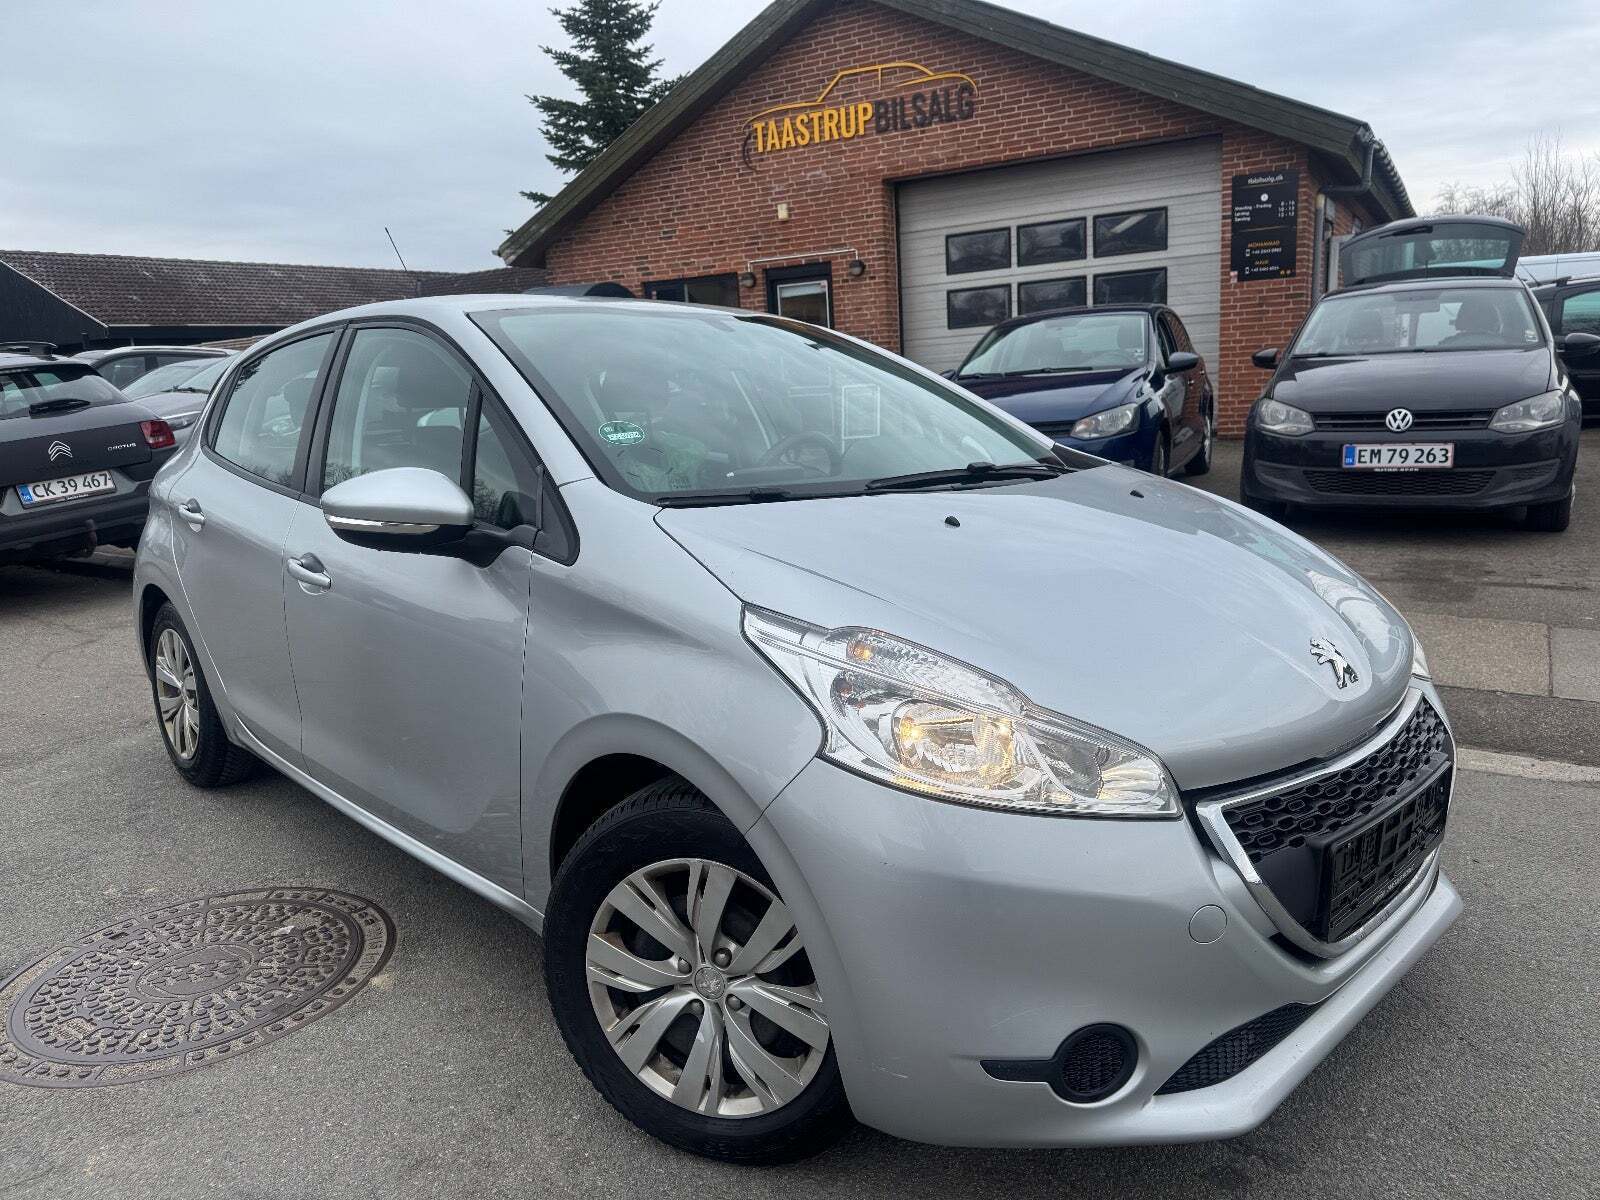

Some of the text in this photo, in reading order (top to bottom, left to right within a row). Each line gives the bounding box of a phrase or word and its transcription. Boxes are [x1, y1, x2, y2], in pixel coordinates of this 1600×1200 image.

[753, 103, 873, 153] TAASTRUP
[1357, 449, 1382, 464] EM
[1386, 448, 1409, 464] 79
[1414, 448, 1449, 464] 263
[32, 482, 56, 498] CK
[57, 478, 78, 494] 39
[82, 473, 109, 490] 467
